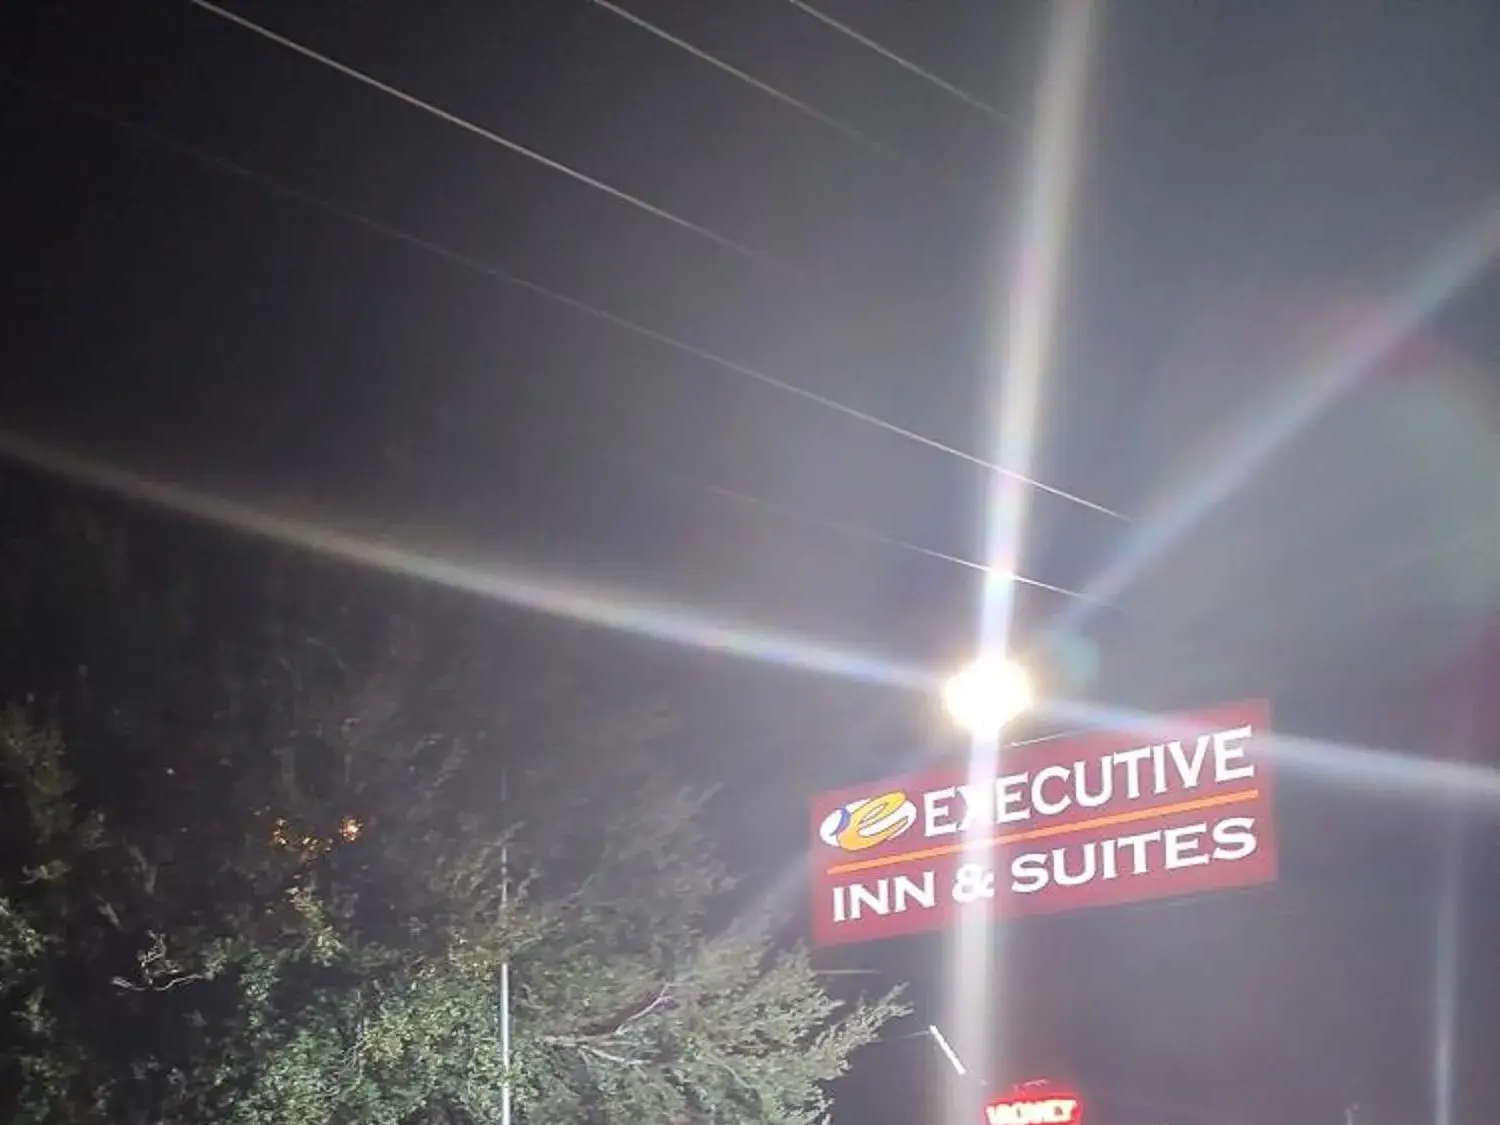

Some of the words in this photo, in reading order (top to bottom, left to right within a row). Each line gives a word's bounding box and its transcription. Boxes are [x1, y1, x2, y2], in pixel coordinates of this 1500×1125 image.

[923, 726, 1255, 837] EXECUTIVE
[832, 870, 935, 922] INN
[952, 863, 995, 901] &
[1011, 817, 1257, 893] SUITES
